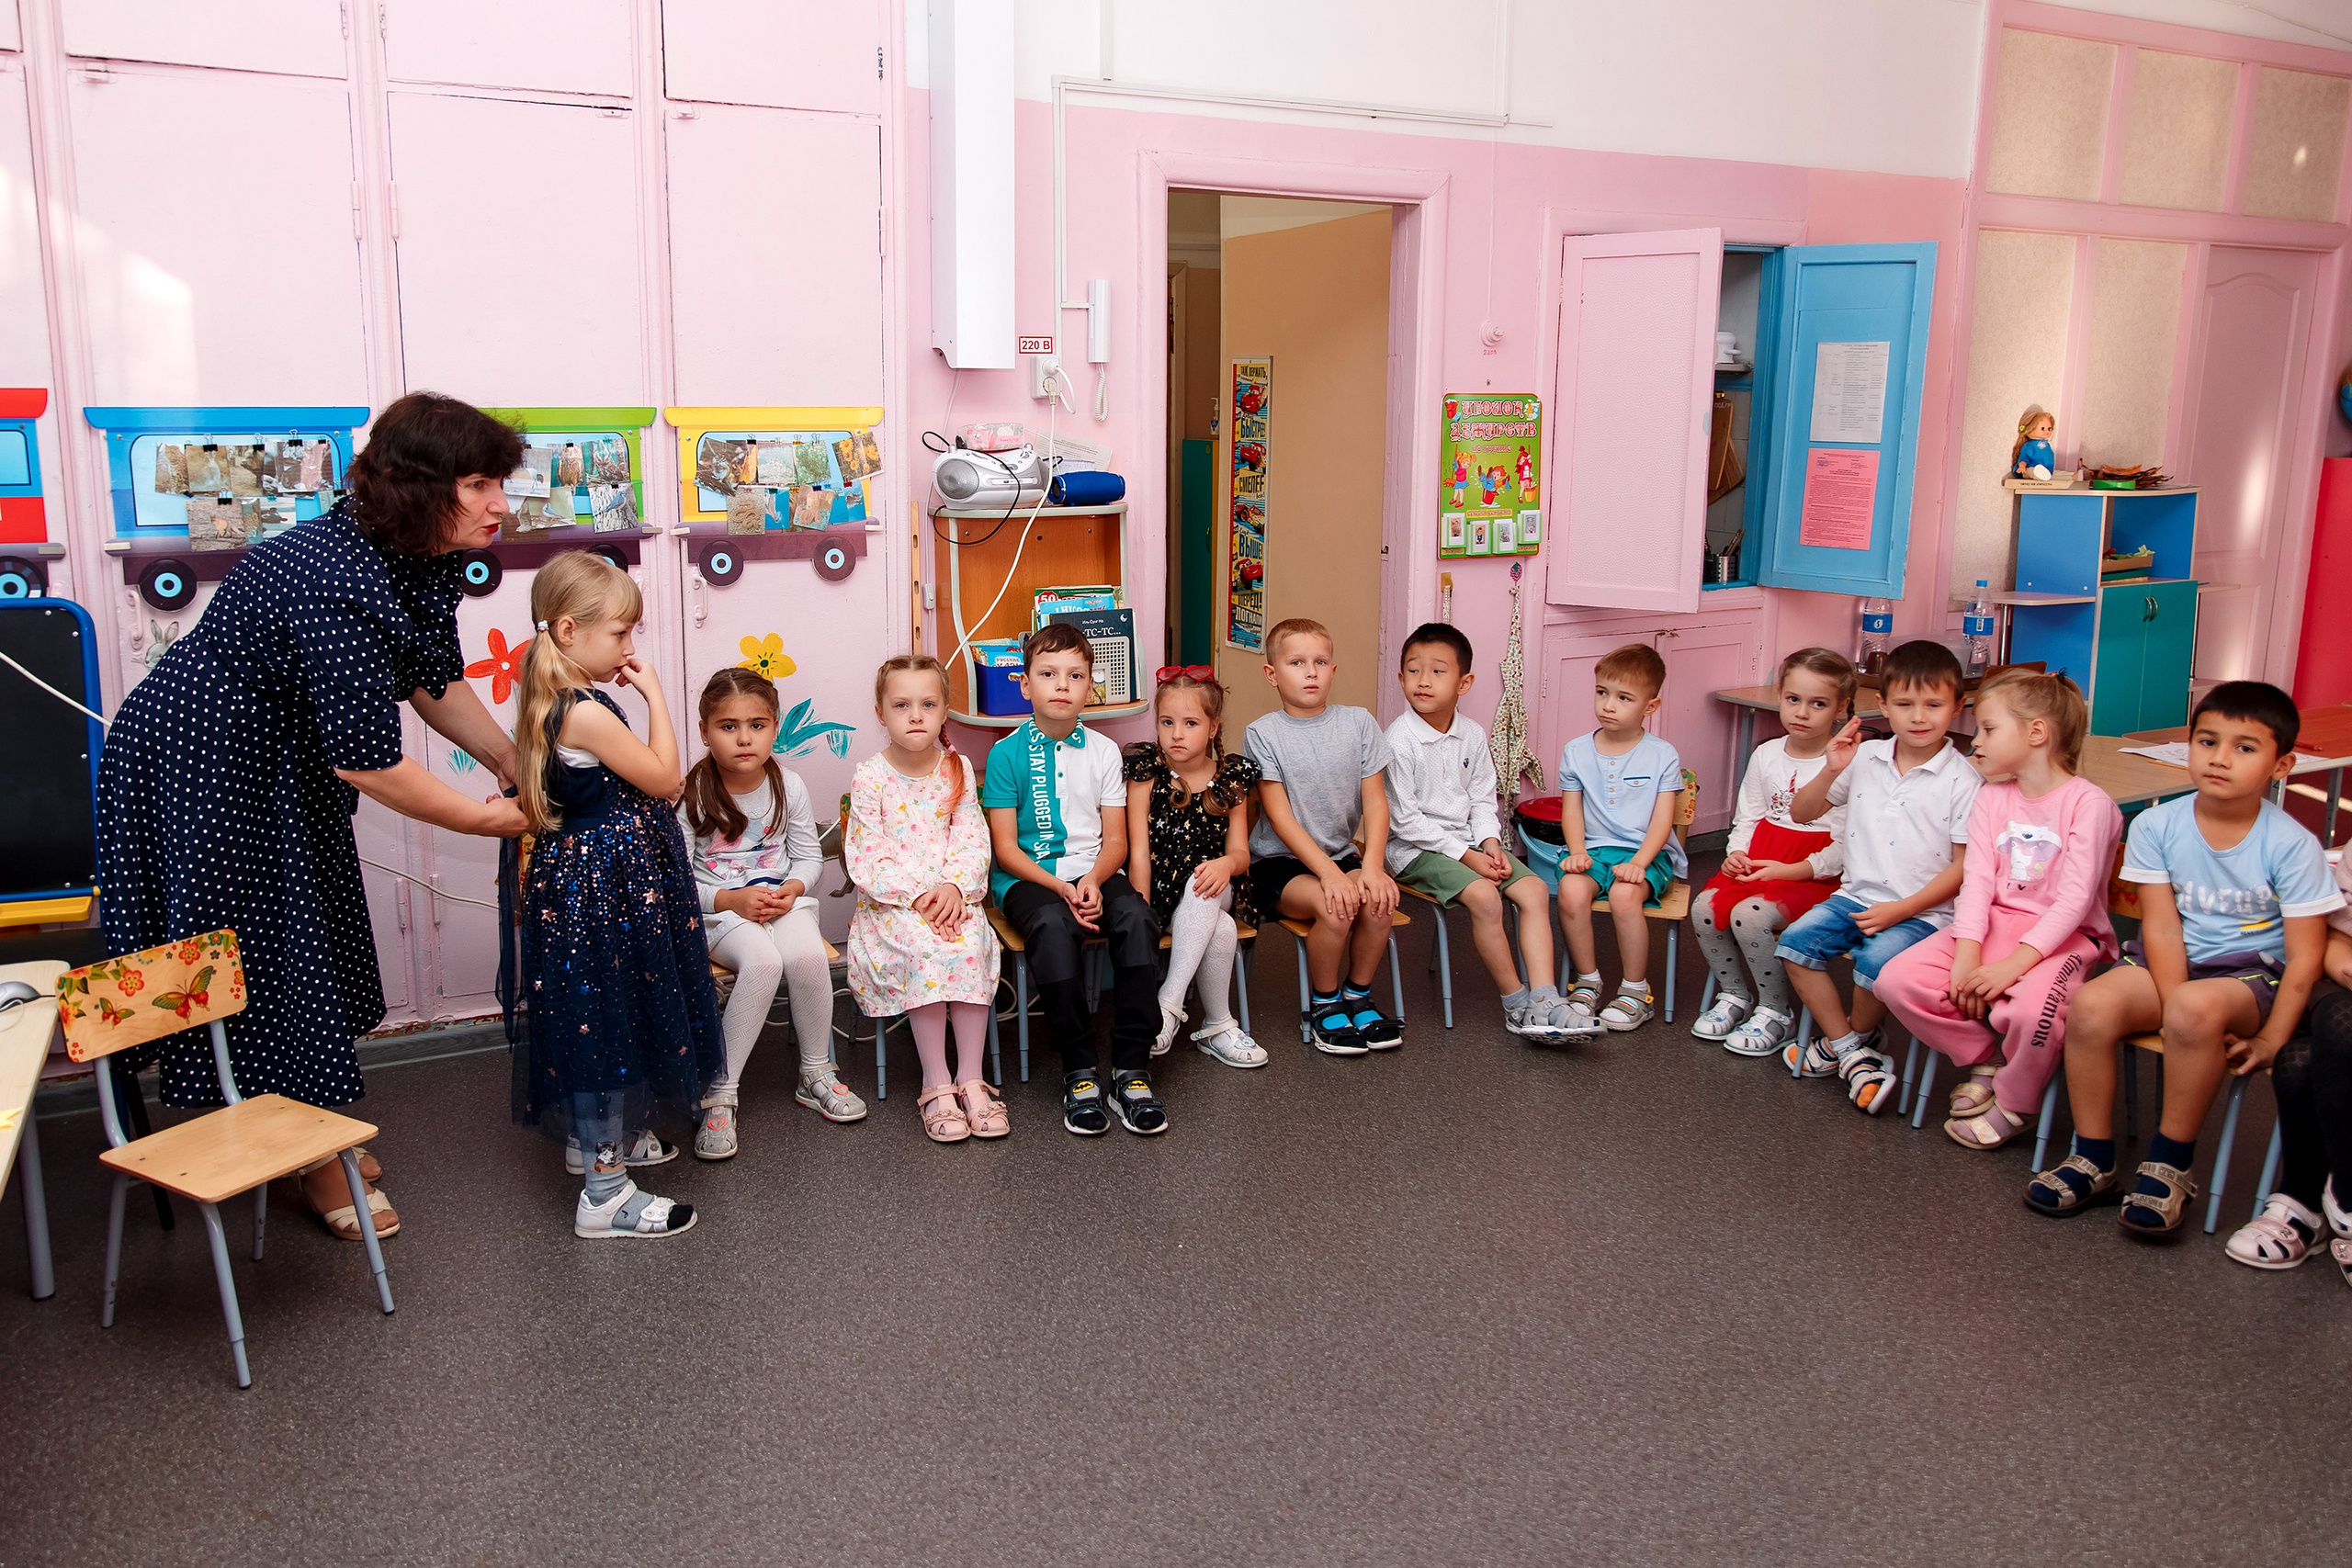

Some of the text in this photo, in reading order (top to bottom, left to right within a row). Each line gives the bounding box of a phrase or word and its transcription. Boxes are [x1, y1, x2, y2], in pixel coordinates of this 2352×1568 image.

[1022, 340, 1051, 350] 220 В
[1450, 422, 1538, 442] ДЕЖУРСТВ
[1239, 534, 1263, 559] ВЫШЕ!
[1028, 744, 1055, 864] STAY PLUGGED IN STA
[2030, 952, 2083, 1048] Almost Famous
